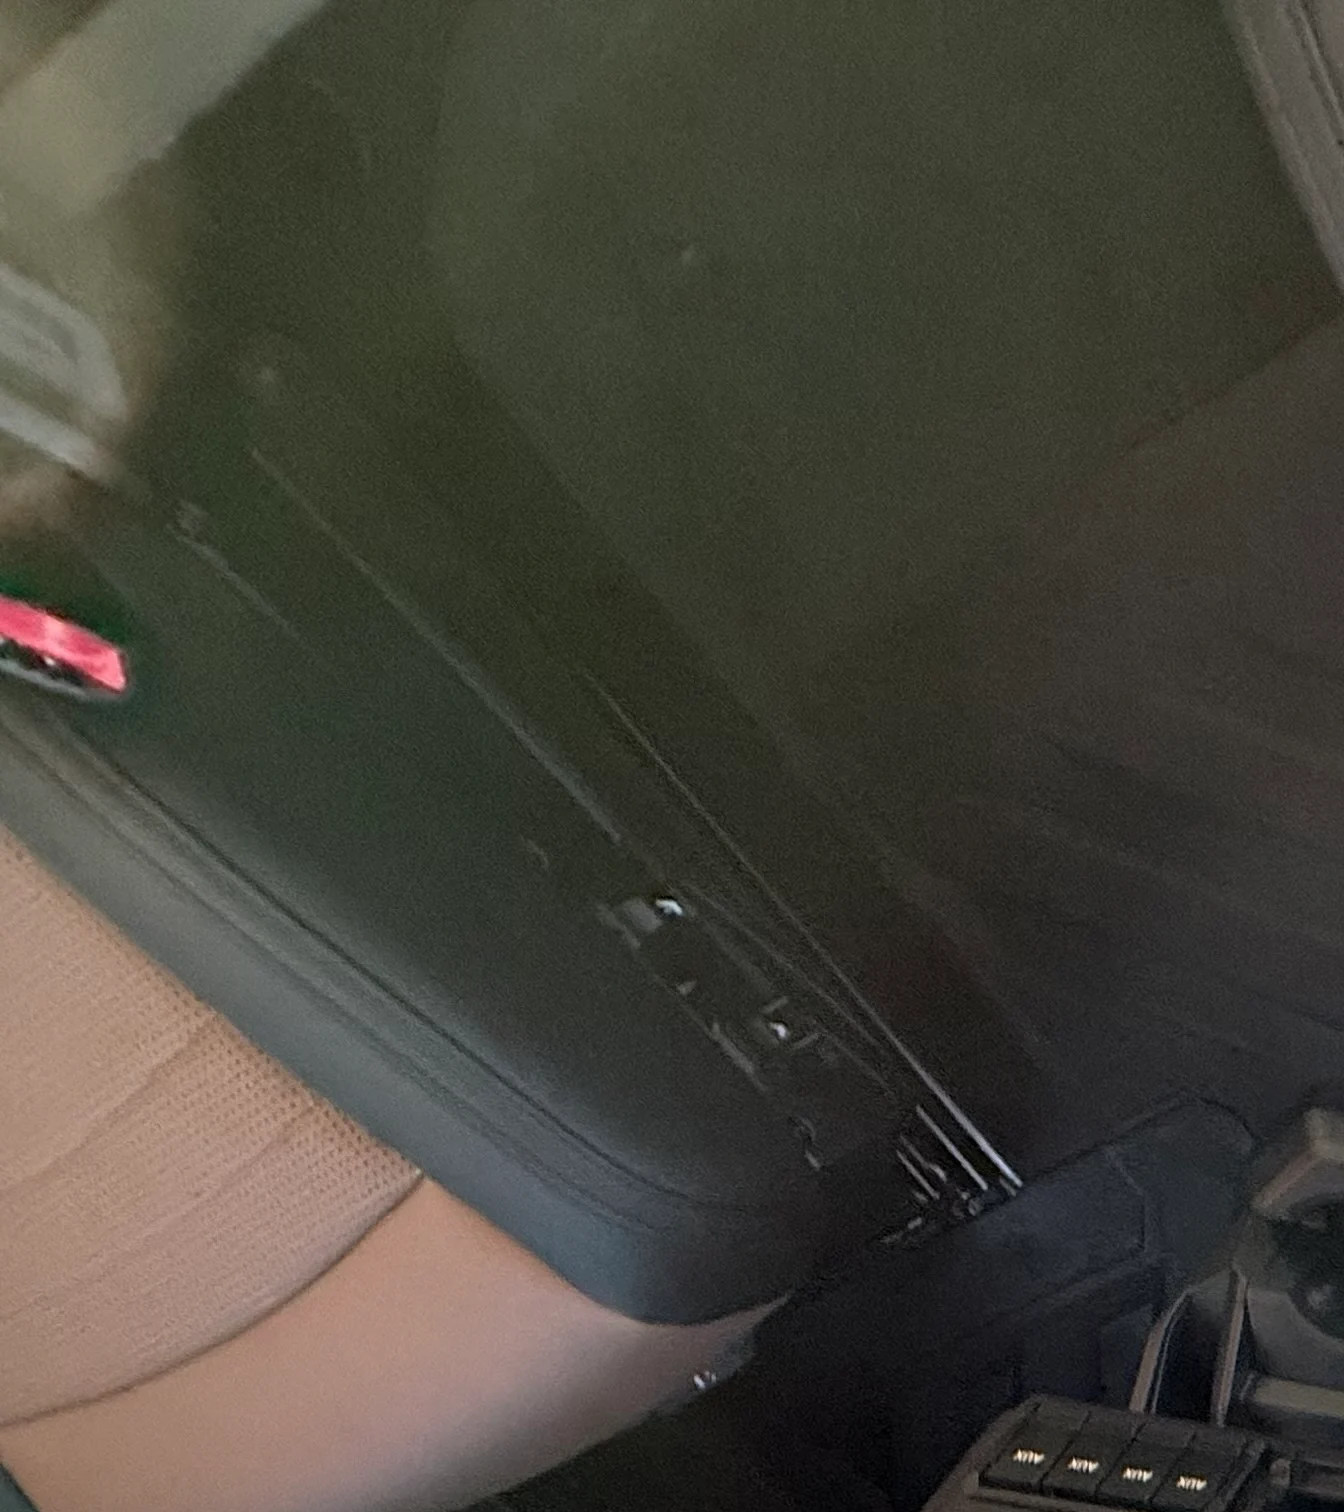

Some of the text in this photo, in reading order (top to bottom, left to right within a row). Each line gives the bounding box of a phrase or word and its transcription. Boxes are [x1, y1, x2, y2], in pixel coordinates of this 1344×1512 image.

[1013, 1449, 1046, 1465] AUX
[1068, 1457, 1099, 1474] AUX
[1122, 1468, 1153, 1483] AUX
[1177, 1476, 1208, 1491] AUX
